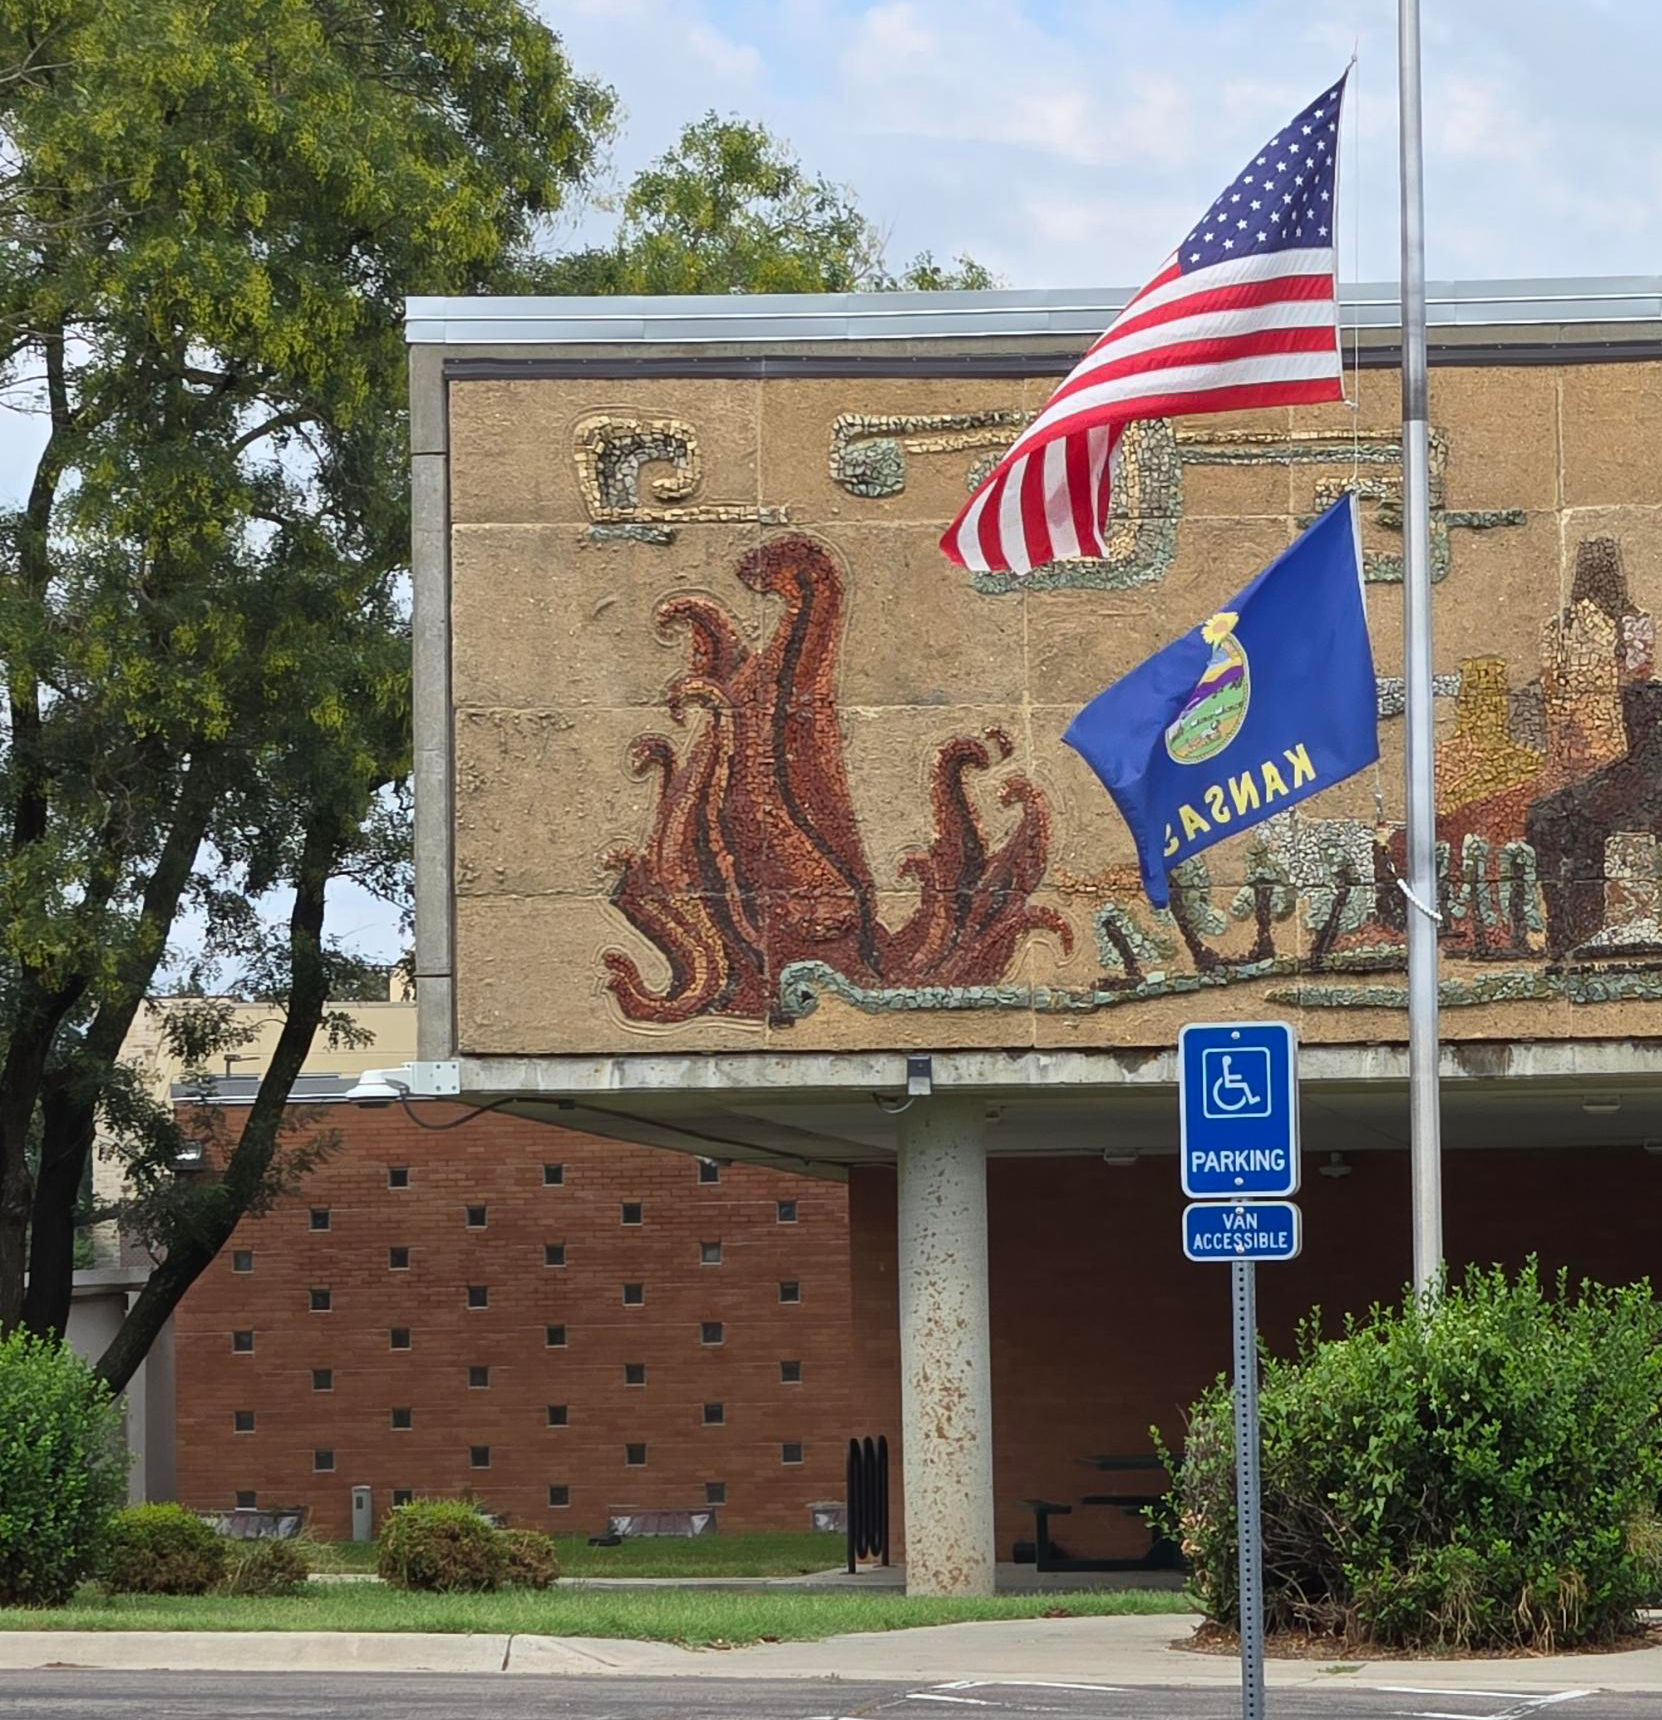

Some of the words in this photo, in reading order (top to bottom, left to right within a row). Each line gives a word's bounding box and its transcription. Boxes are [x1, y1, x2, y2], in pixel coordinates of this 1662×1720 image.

[1191, 1149, 1286, 1173] PARKING
[1222, 1213, 1258, 1230] VAN
[1193, 1231, 1288, 1250] ACCESSIBLE
